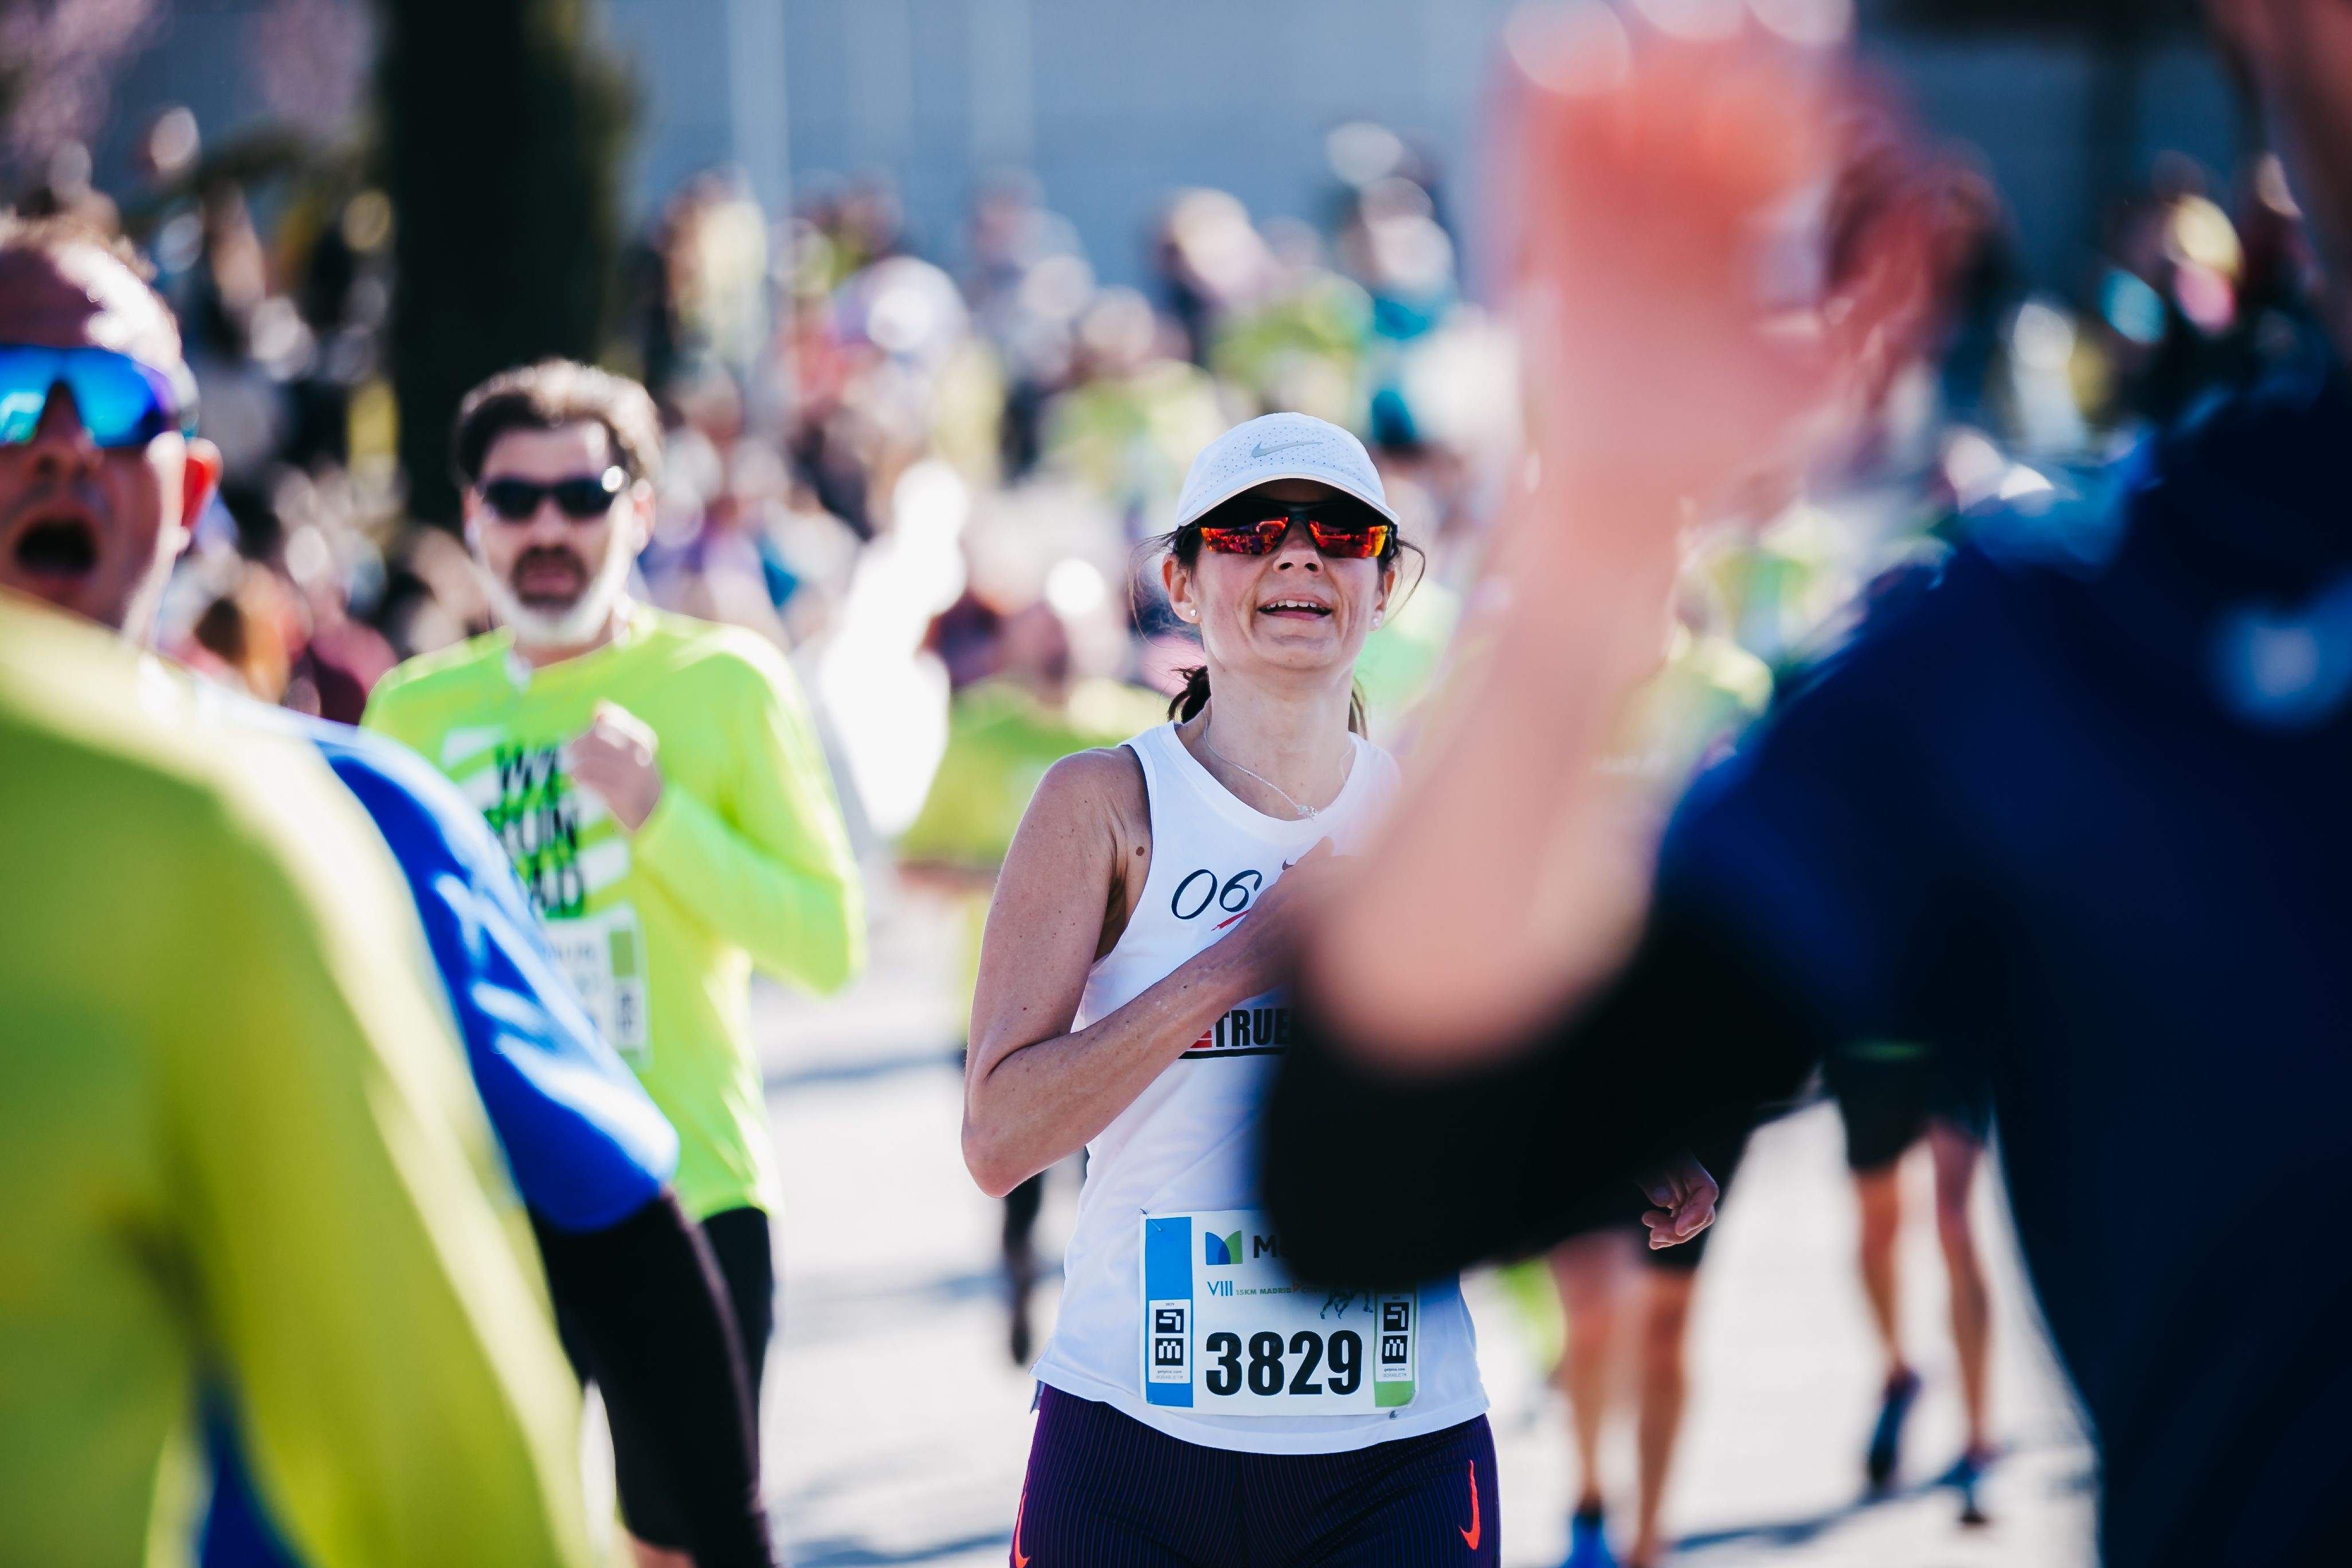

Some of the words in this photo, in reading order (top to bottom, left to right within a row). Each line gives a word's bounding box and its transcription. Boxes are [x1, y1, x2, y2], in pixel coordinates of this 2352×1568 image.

[1171, 869, 1263, 920] 06
[1207, 1280, 1233, 1296] VIII
[1206, 1330, 1363, 1396] 3829
